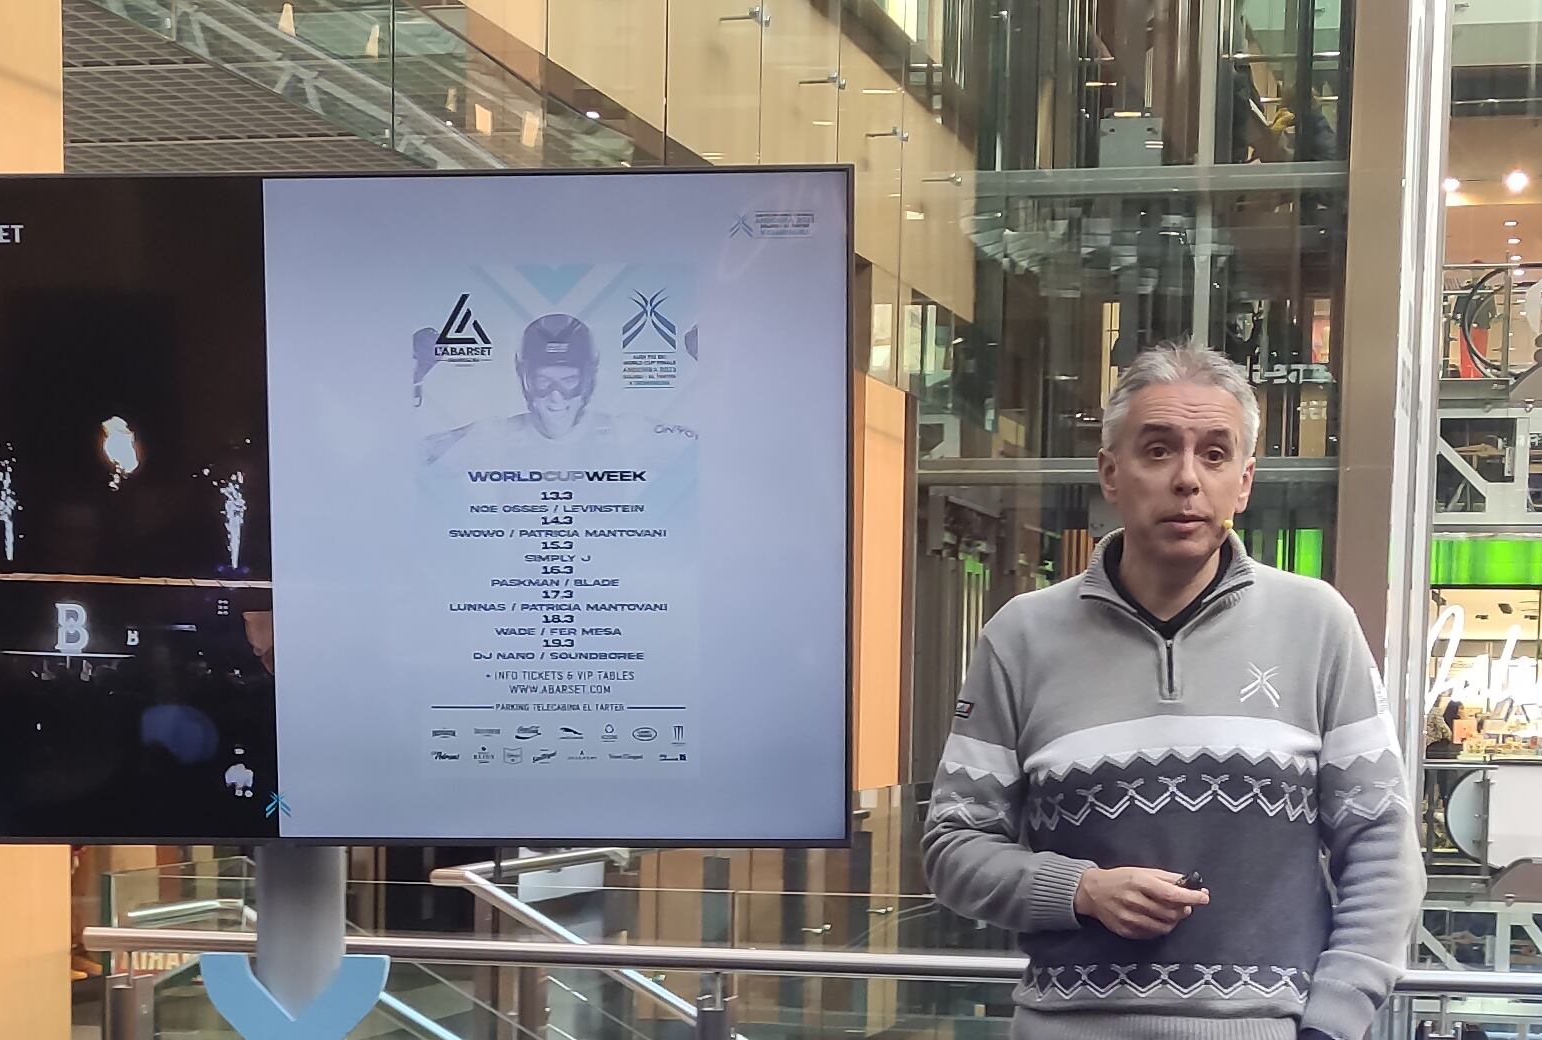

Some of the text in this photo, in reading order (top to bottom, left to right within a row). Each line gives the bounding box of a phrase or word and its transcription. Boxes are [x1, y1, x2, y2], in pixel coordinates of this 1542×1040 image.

[541, 491, 573, 501] 13.3
[563, 505, 644, 513] LEVINSTEIN
[541, 516, 573, 525] 14.3
[519, 529, 580, 538] PATRICIA
[585, 529, 667, 538] MANTOVANI
[541, 541, 573, 550] 15.3
[541, 565, 574, 574] 16.3
[574, 579, 619, 587] BLADE
[542, 590, 574, 599] 17.3
[520, 603, 581, 611] PATRICIA
[586, 603, 667, 611] MANTOVANI
[542, 614, 575, 623] 18.3
[495, 628, 536, 636] WADE
[550, 628, 577, 636] FER
[581, 628, 621, 636] MESA
[542, 639, 575, 648] 19.3
[494, 671, 518, 681] INFO
[522, 671, 563, 681] TICKETS
[577, 671, 594, 681] VIP
[597, 671, 635, 681] TABLES
[509, 684, 612, 694] WWW.ABARSET.COM
